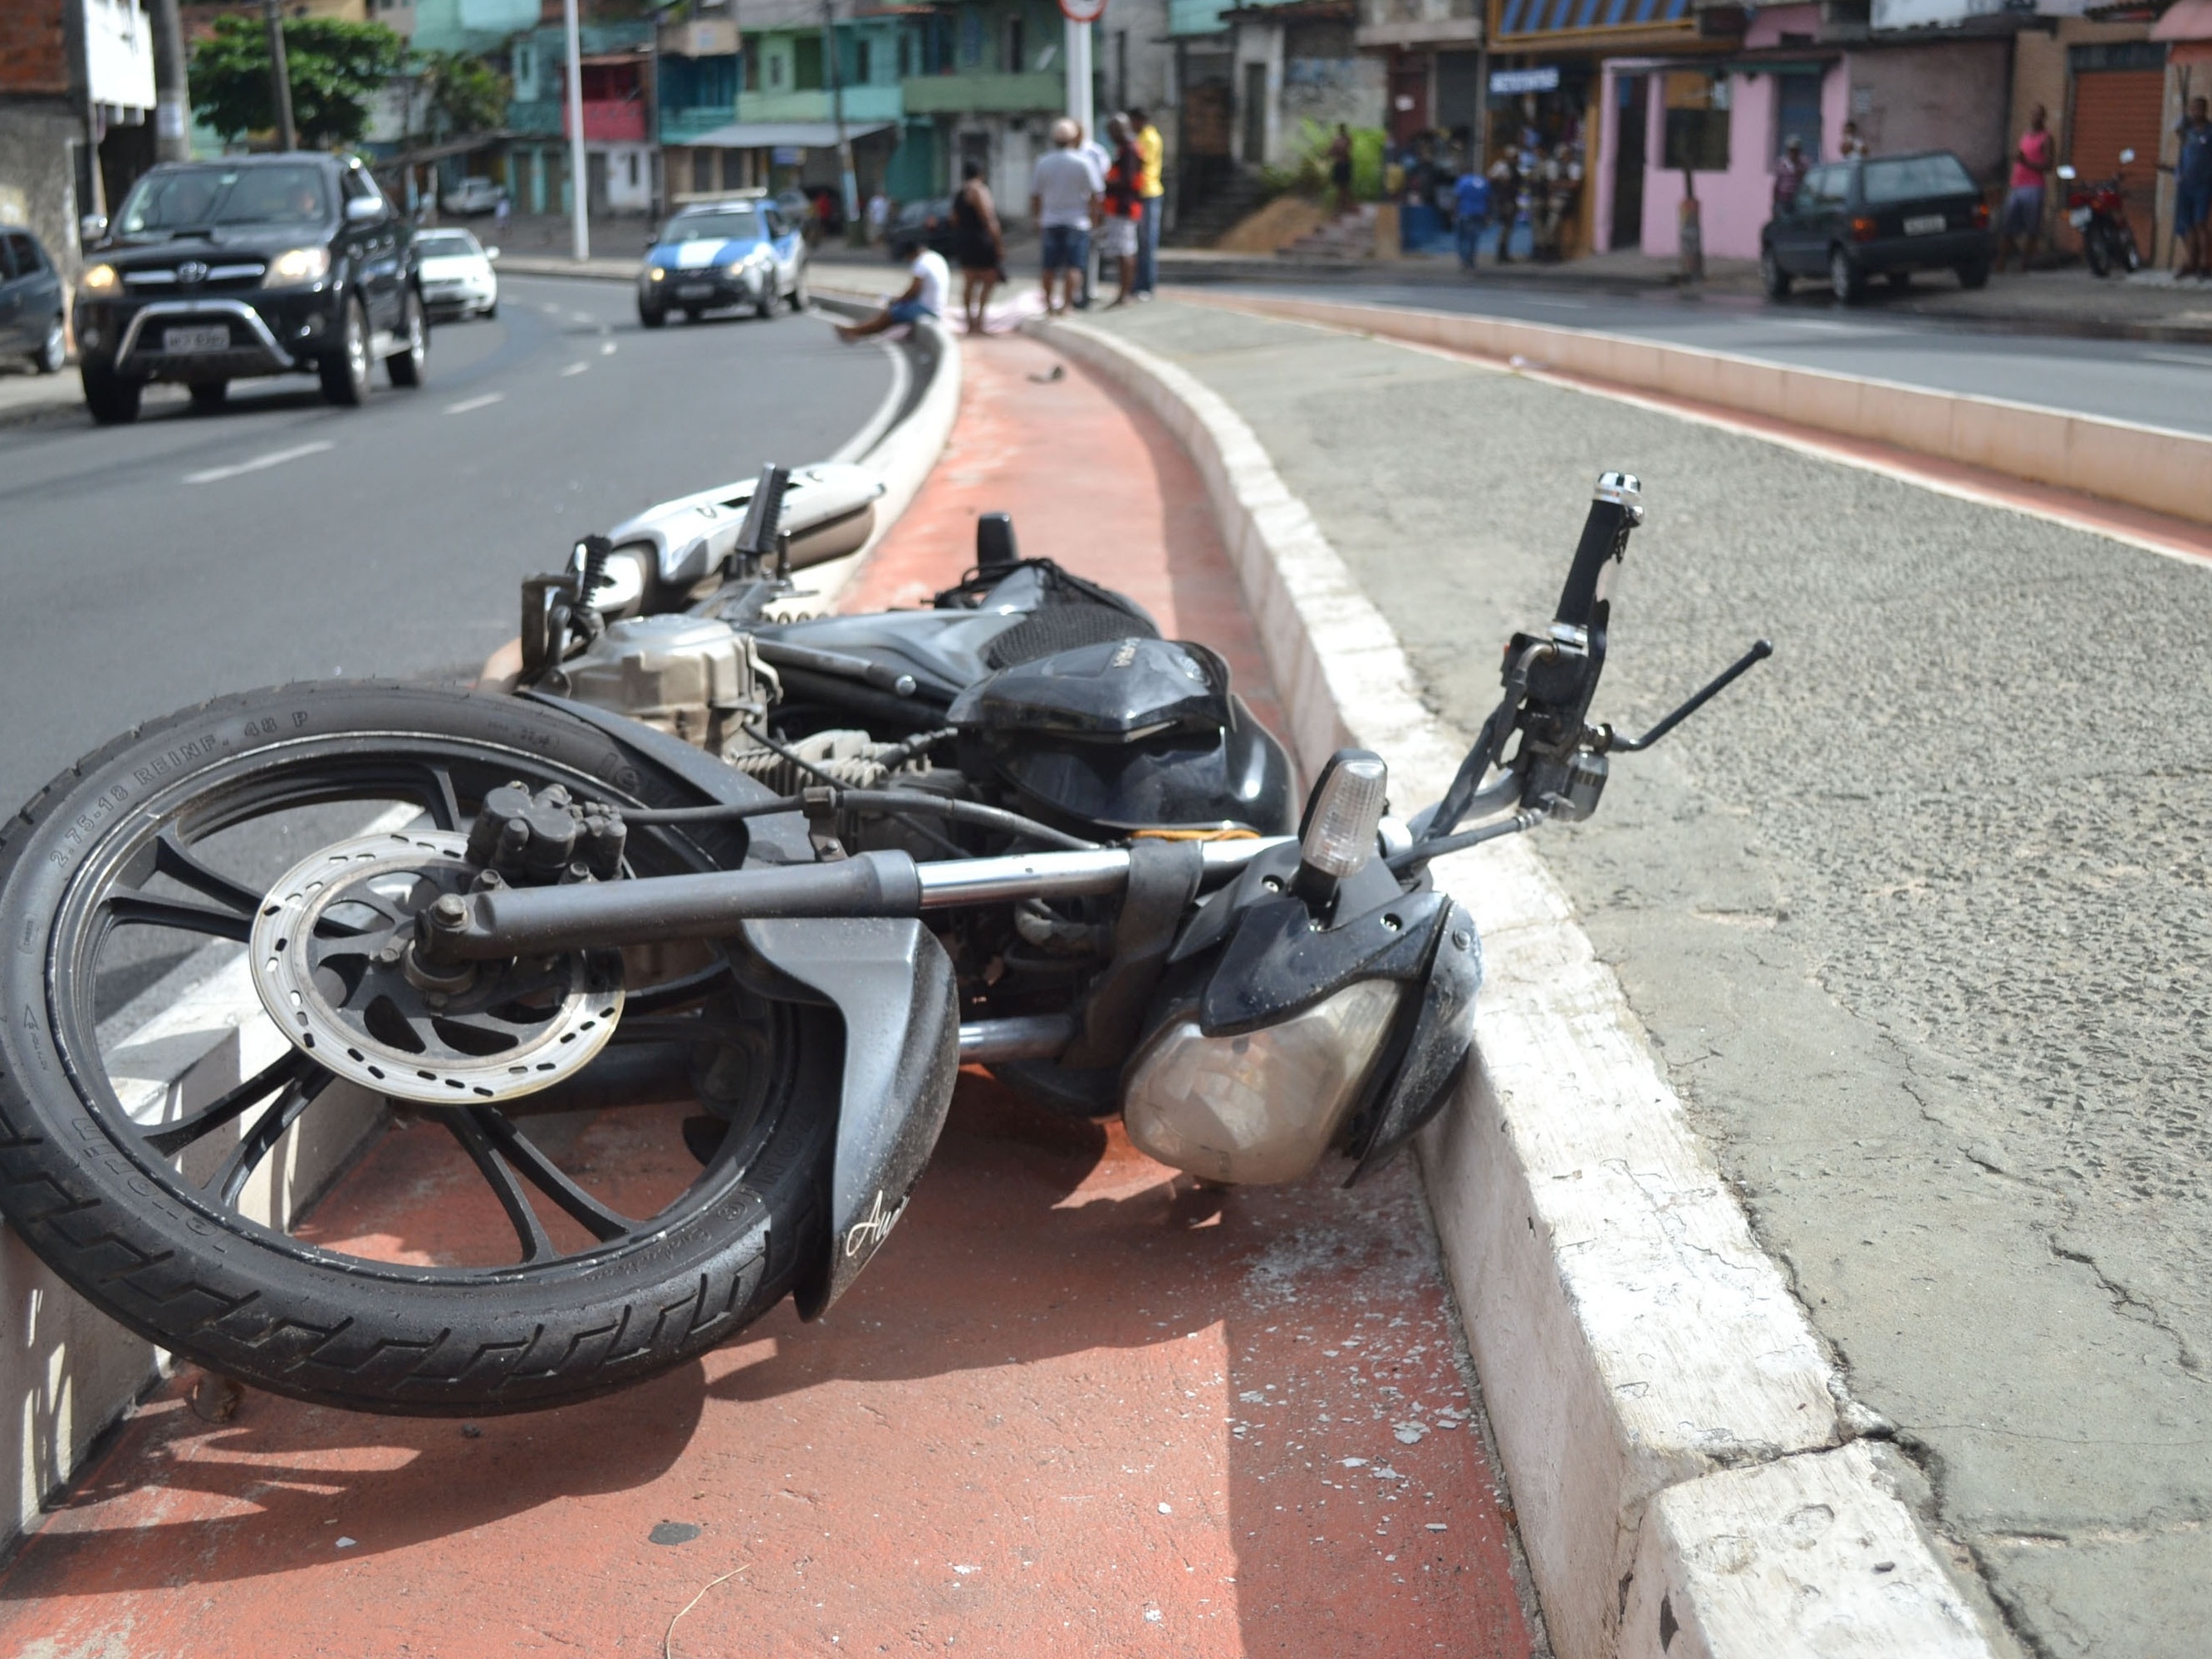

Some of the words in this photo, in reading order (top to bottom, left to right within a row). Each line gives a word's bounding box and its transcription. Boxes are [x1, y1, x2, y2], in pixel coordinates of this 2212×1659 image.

[50, 784, 128, 868] 2.75-18
[133, 734, 230, 786] REINF.
[244, 717, 277, 738] 48
[292, 711, 308, 728] P
